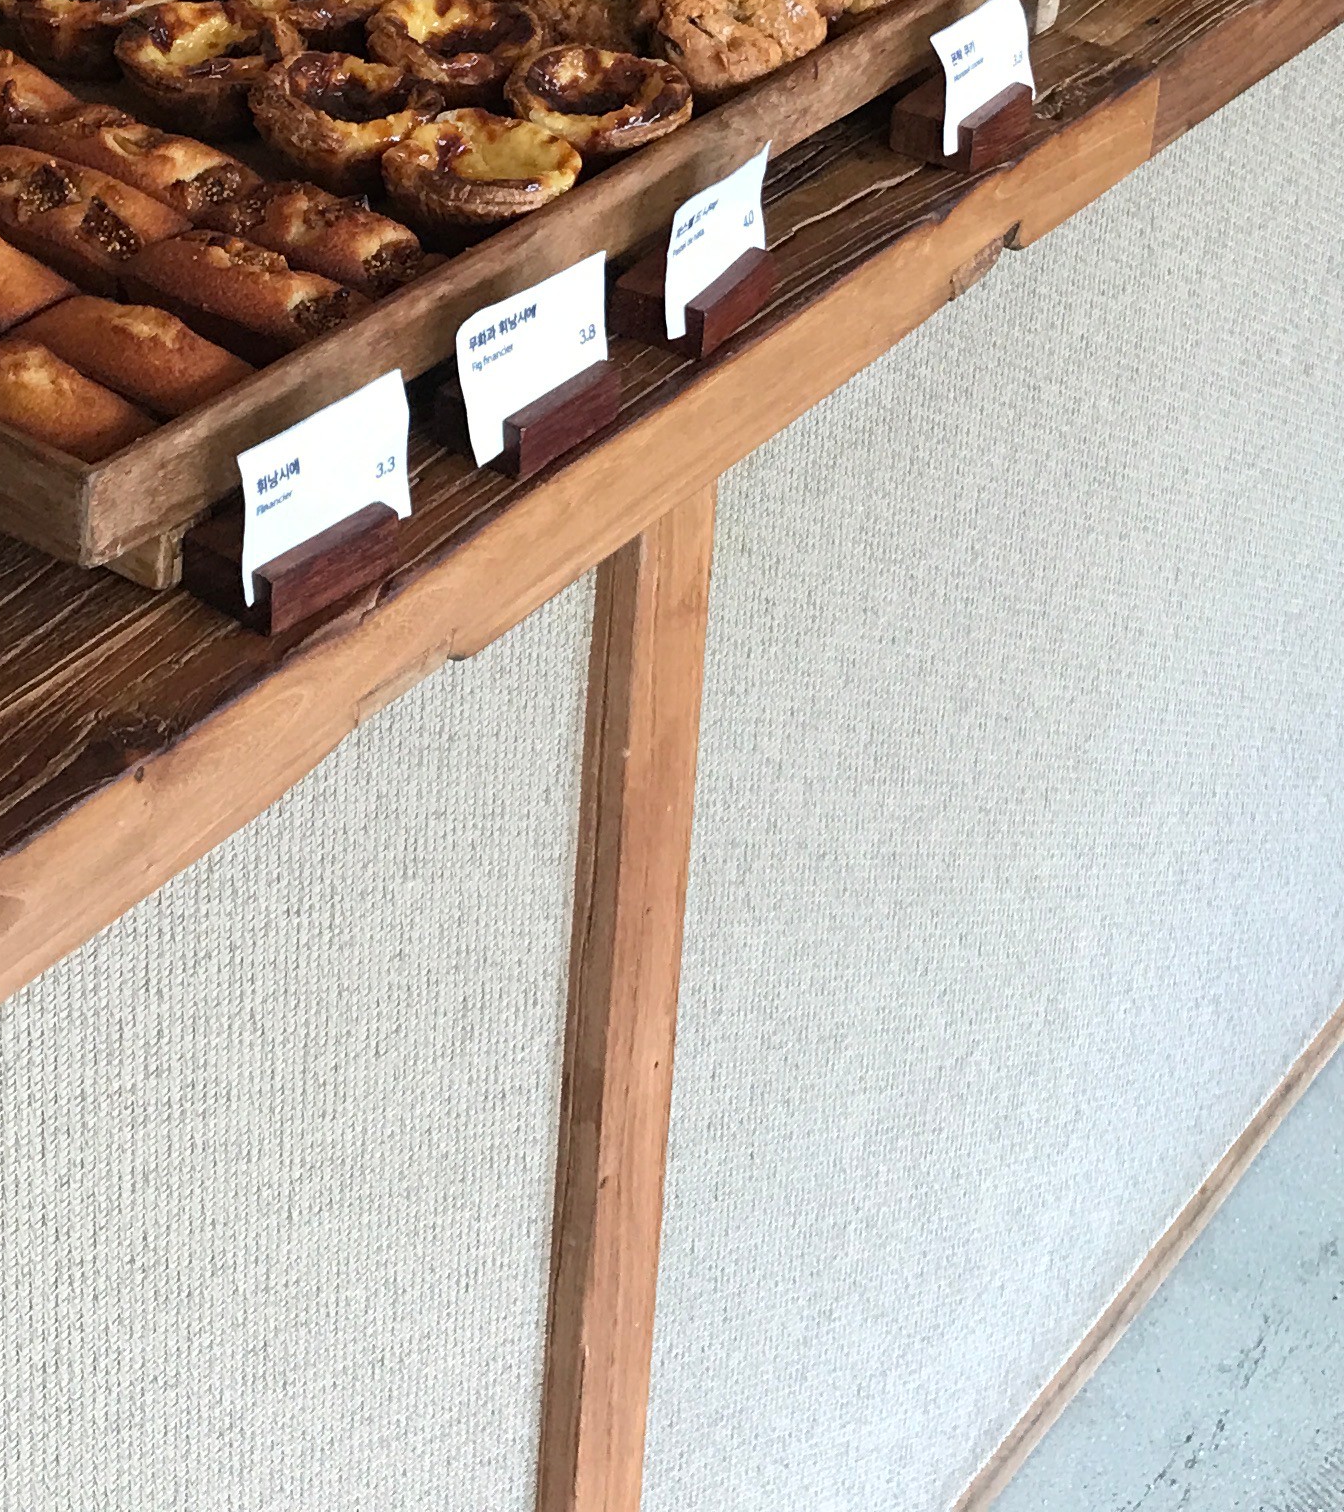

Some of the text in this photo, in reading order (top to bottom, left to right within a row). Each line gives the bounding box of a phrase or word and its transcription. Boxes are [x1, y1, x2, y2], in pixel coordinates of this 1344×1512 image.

[742, 209, 755, 228] 4.0
[468, 303, 538, 352] 무화과 휘낭시에
[578, 323, 597, 345] 3.8
[471, 343, 514, 372] Fig financier
[256, 457, 301, 495] 휘낭시에
[375, 455, 396, 479] 3.3
[256, 490, 294, 516] Financier
